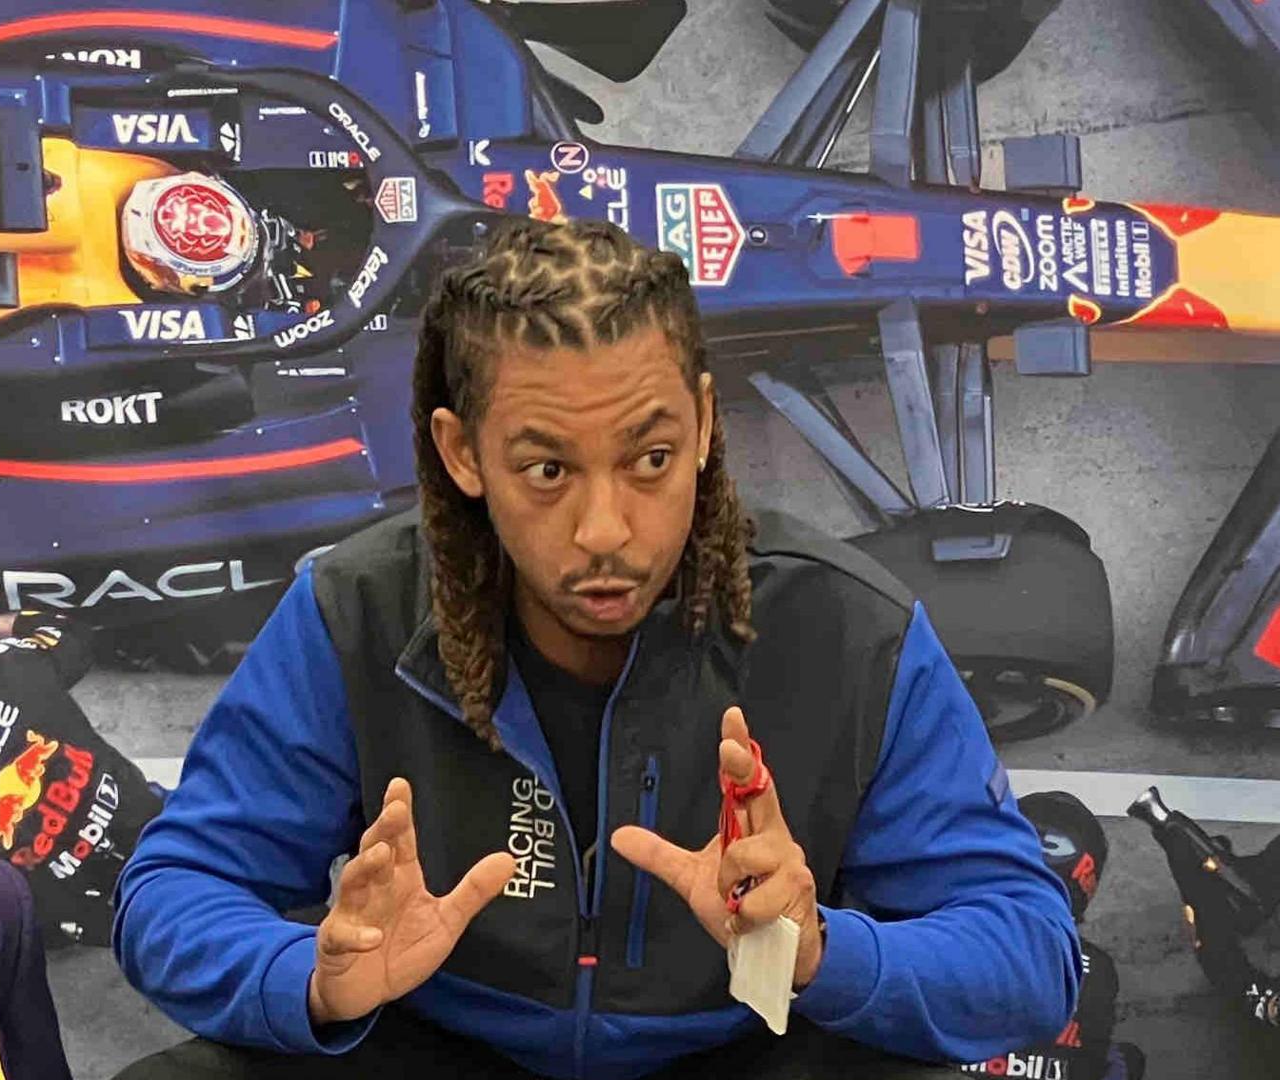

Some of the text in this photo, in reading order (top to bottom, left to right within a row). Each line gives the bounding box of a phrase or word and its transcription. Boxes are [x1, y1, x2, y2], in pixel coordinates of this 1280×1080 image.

[112, 113, 198, 144] VISA
[328, 103, 381, 163] ORACLE
[328, 151, 364, 168] obil
[665, 193, 689, 268] AG
[699, 191, 734, 279] HEUER
[962, 210, 990, 285] VISA
[1001, 229, 1022, 290] CDW
[1060, 216, 1075, 265] ARCTIC
[1073, 222, 1087, 260] WOLF
[348, 246, 389, 308] telcel
[1133, 242, 1152, 298] Mobil
[119, 310, 205, 340] VISA
[60, 392, 163, 425] ROKT
[49, 804, 114, 879] Mobil
[530, 818, 556, 898] BULL
